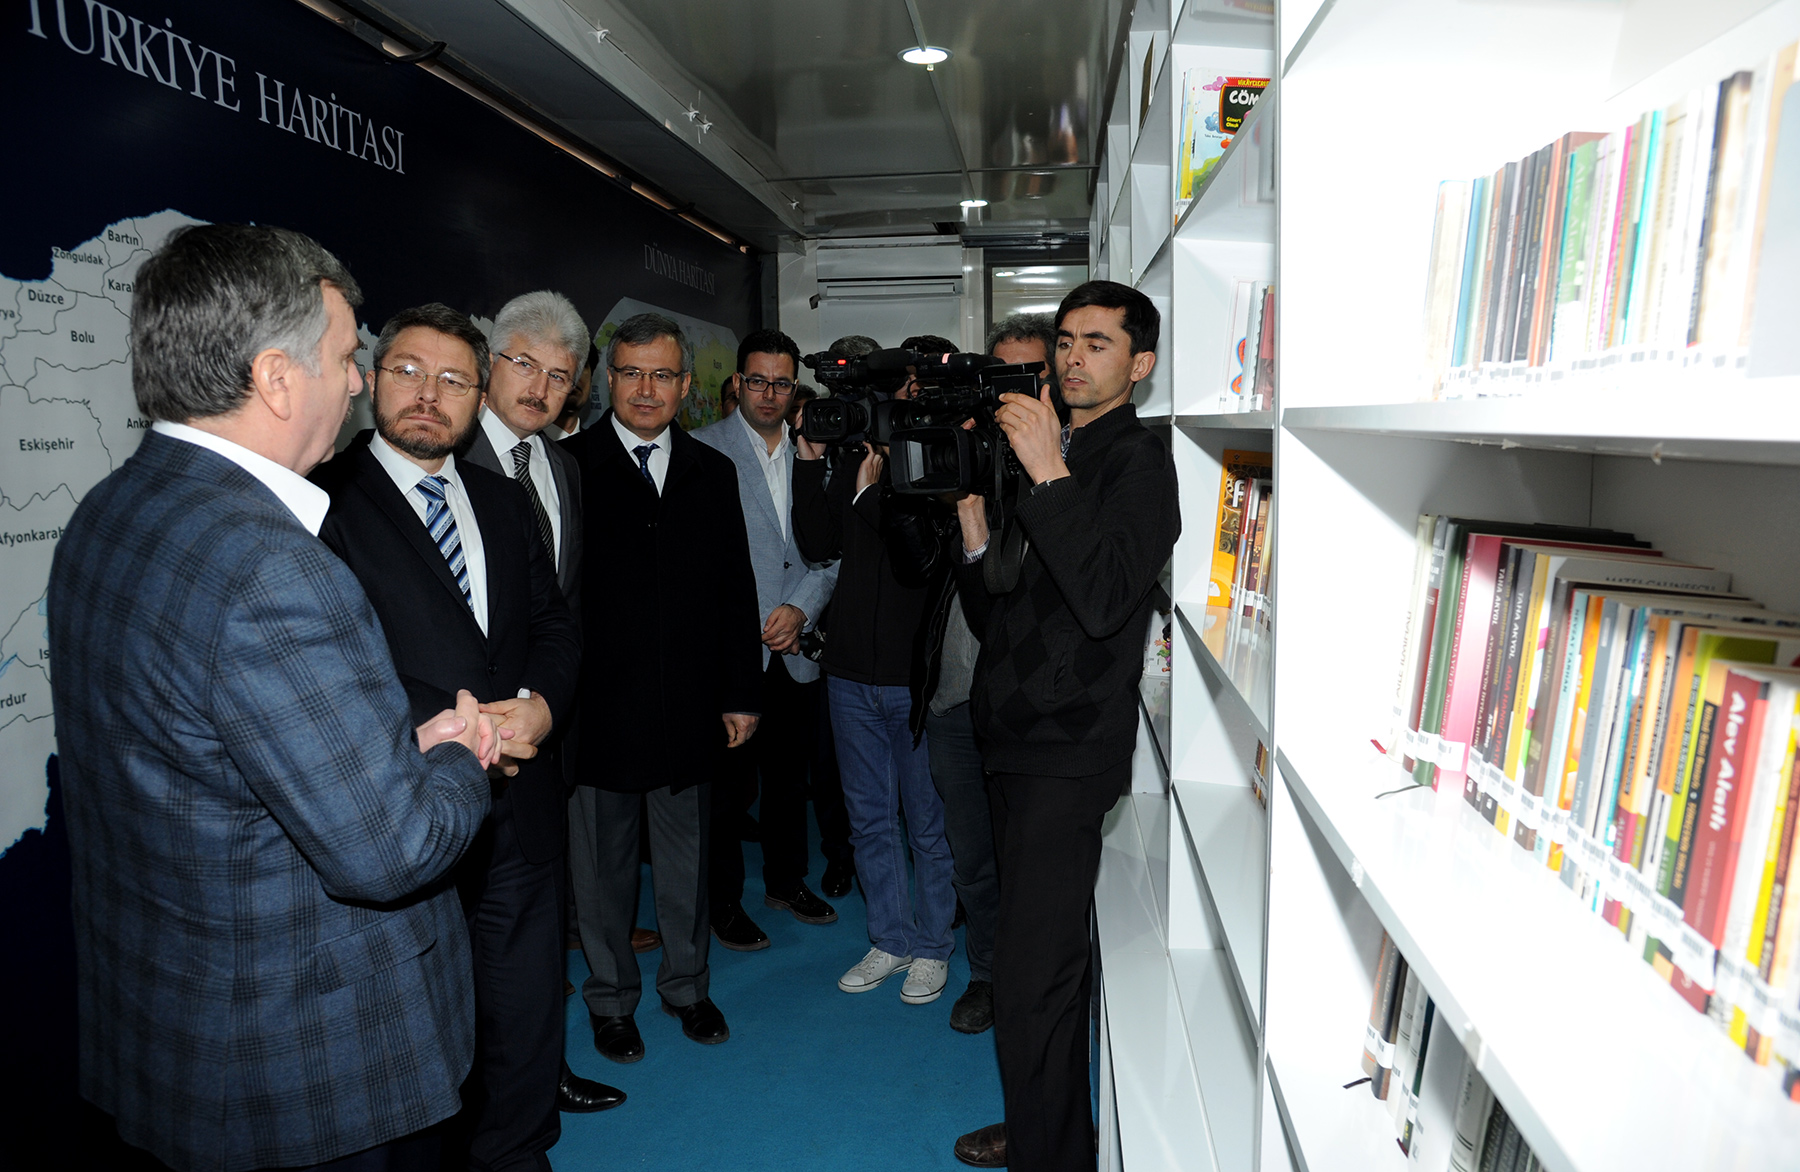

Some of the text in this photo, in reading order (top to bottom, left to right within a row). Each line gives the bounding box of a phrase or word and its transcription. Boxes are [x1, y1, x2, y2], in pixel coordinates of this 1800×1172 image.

[255, 71, 406, 175] HARİTASI
[107, 229, 139, 246] Bartın
[53, 247, 104, 266] Zonguldak
[644, 242, 715, 296] DÜNYA HARİTASI
[28, 289, 64, 305] Düzce
[71, 330, 95, 344] Bolu
[19, 438, 75, 454] Eskişehir
[1498, 567, 1506, 593] TAHA
[1491, 595, 1502, 626] AKYOL
[1515, 591, 1525, 620] TAHA
[1508, 622, 1520, 659] AKYOL
[1570, 608, 1580, 647] NEVZAT
[1562, 652, 1573, 692] TARHAN
[1709, 690, 1746, 831] Alev Alatlı
